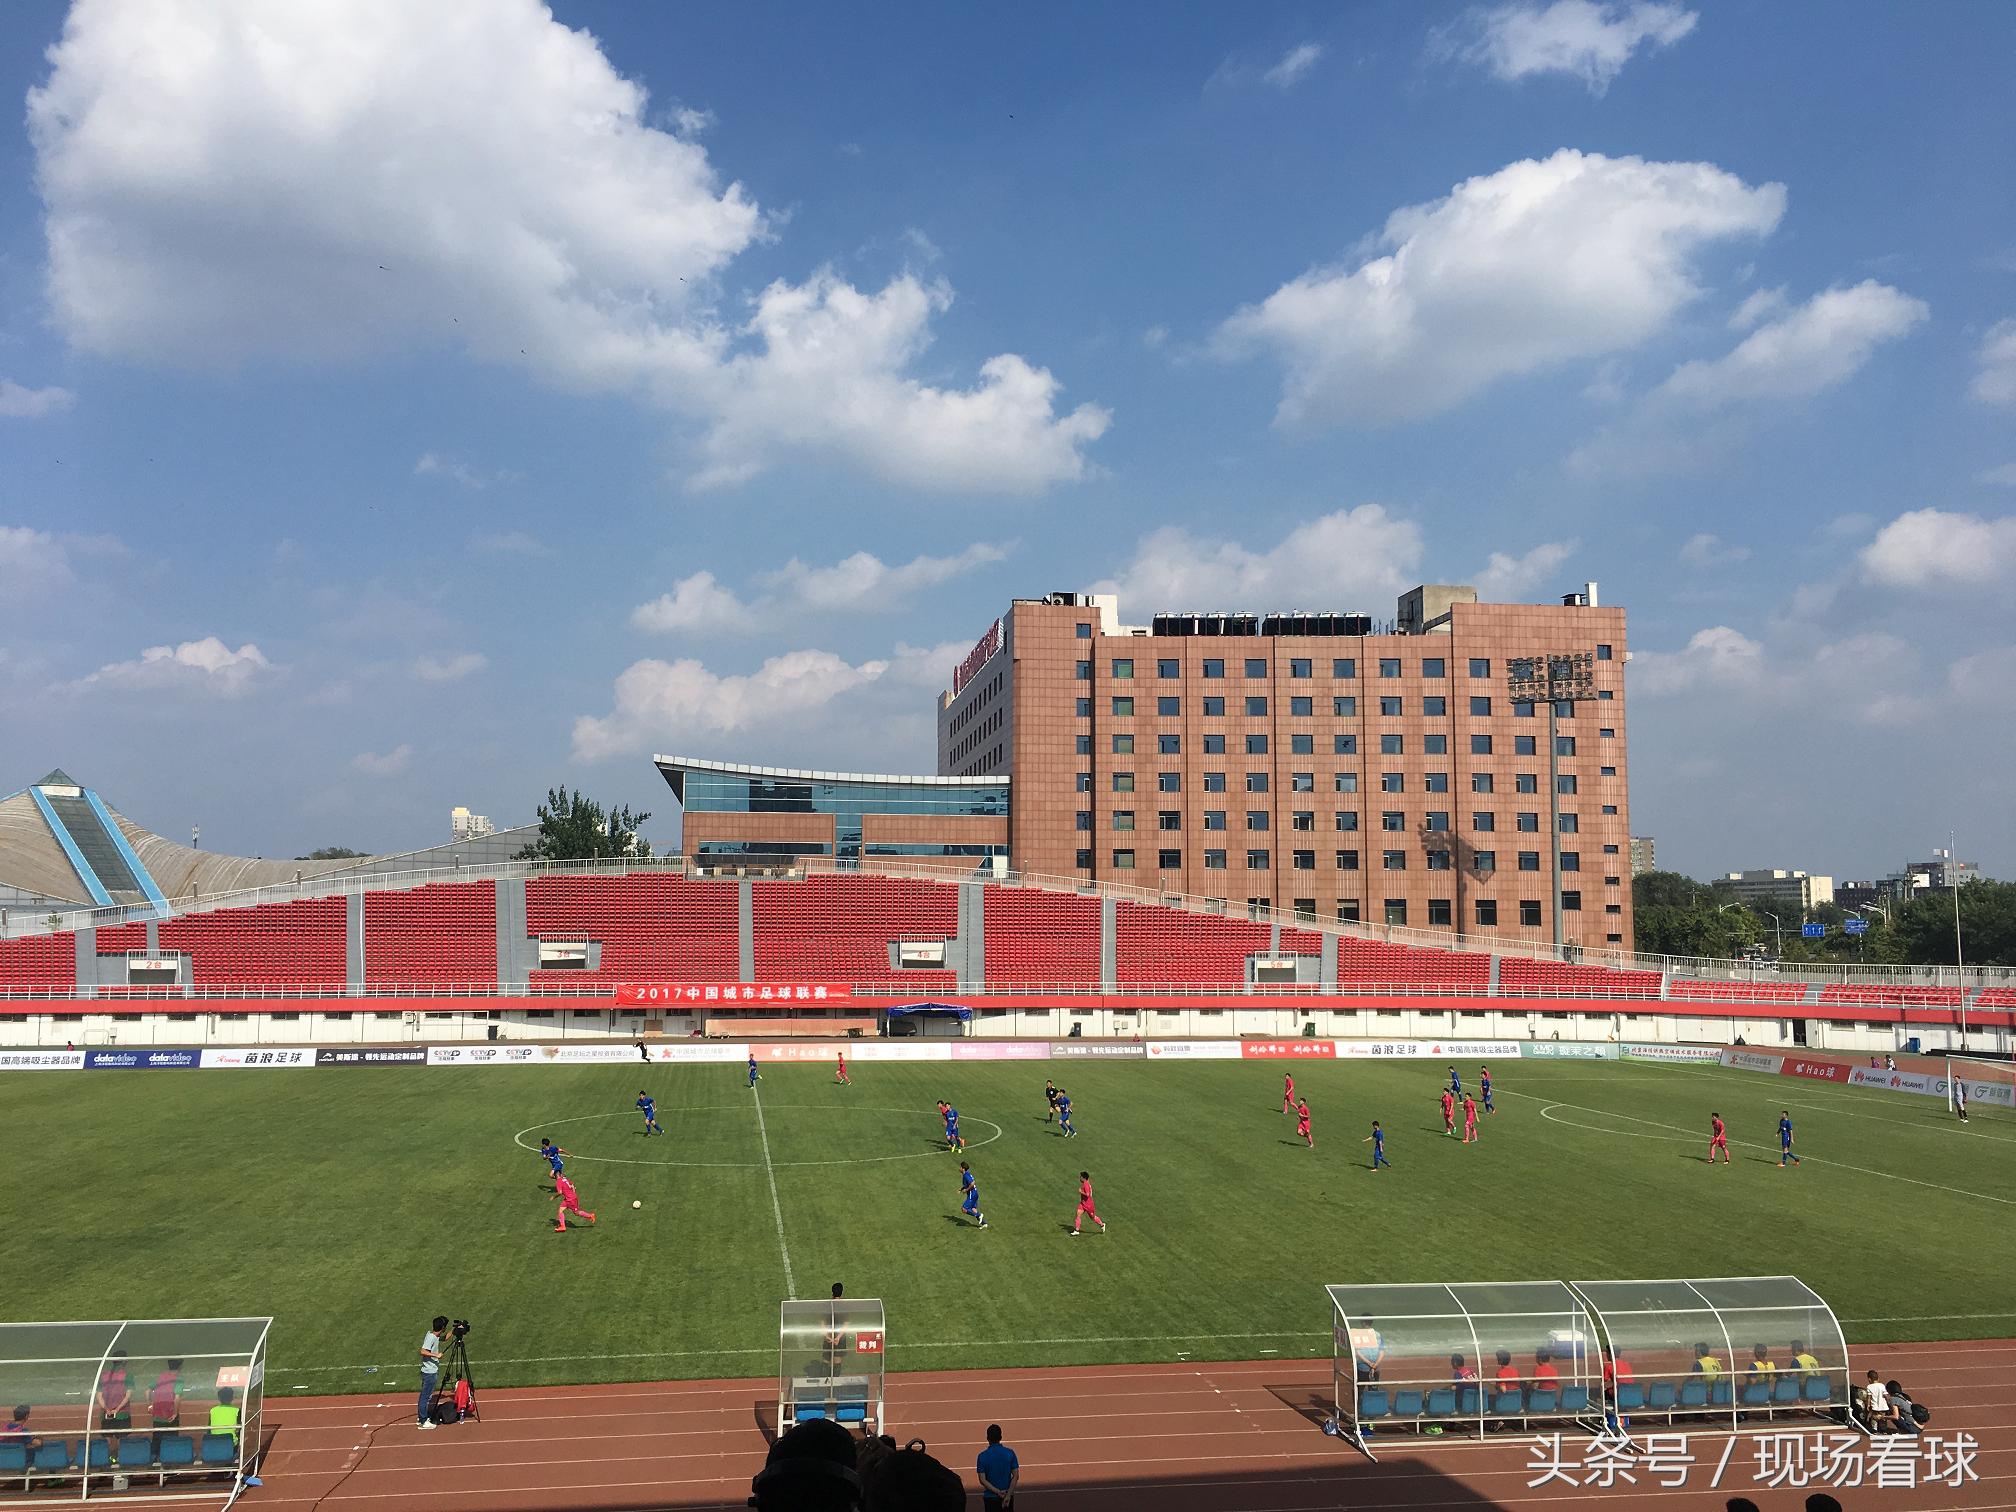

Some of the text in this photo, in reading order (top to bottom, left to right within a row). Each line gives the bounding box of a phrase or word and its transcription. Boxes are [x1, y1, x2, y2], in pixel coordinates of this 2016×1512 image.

[146, 961, 162, 969] 2台
[637, 986, 828, 1000] 2017中国城市足球联赛
[1371, 1044, 1417, 1055] 茵浪足球
[245, 1052, 303, 1064] 茵浪足球
[1865, 1076, 1887, 1084] HUAWEI
[1902, 1081, 1924, 1089] HUAWEI
